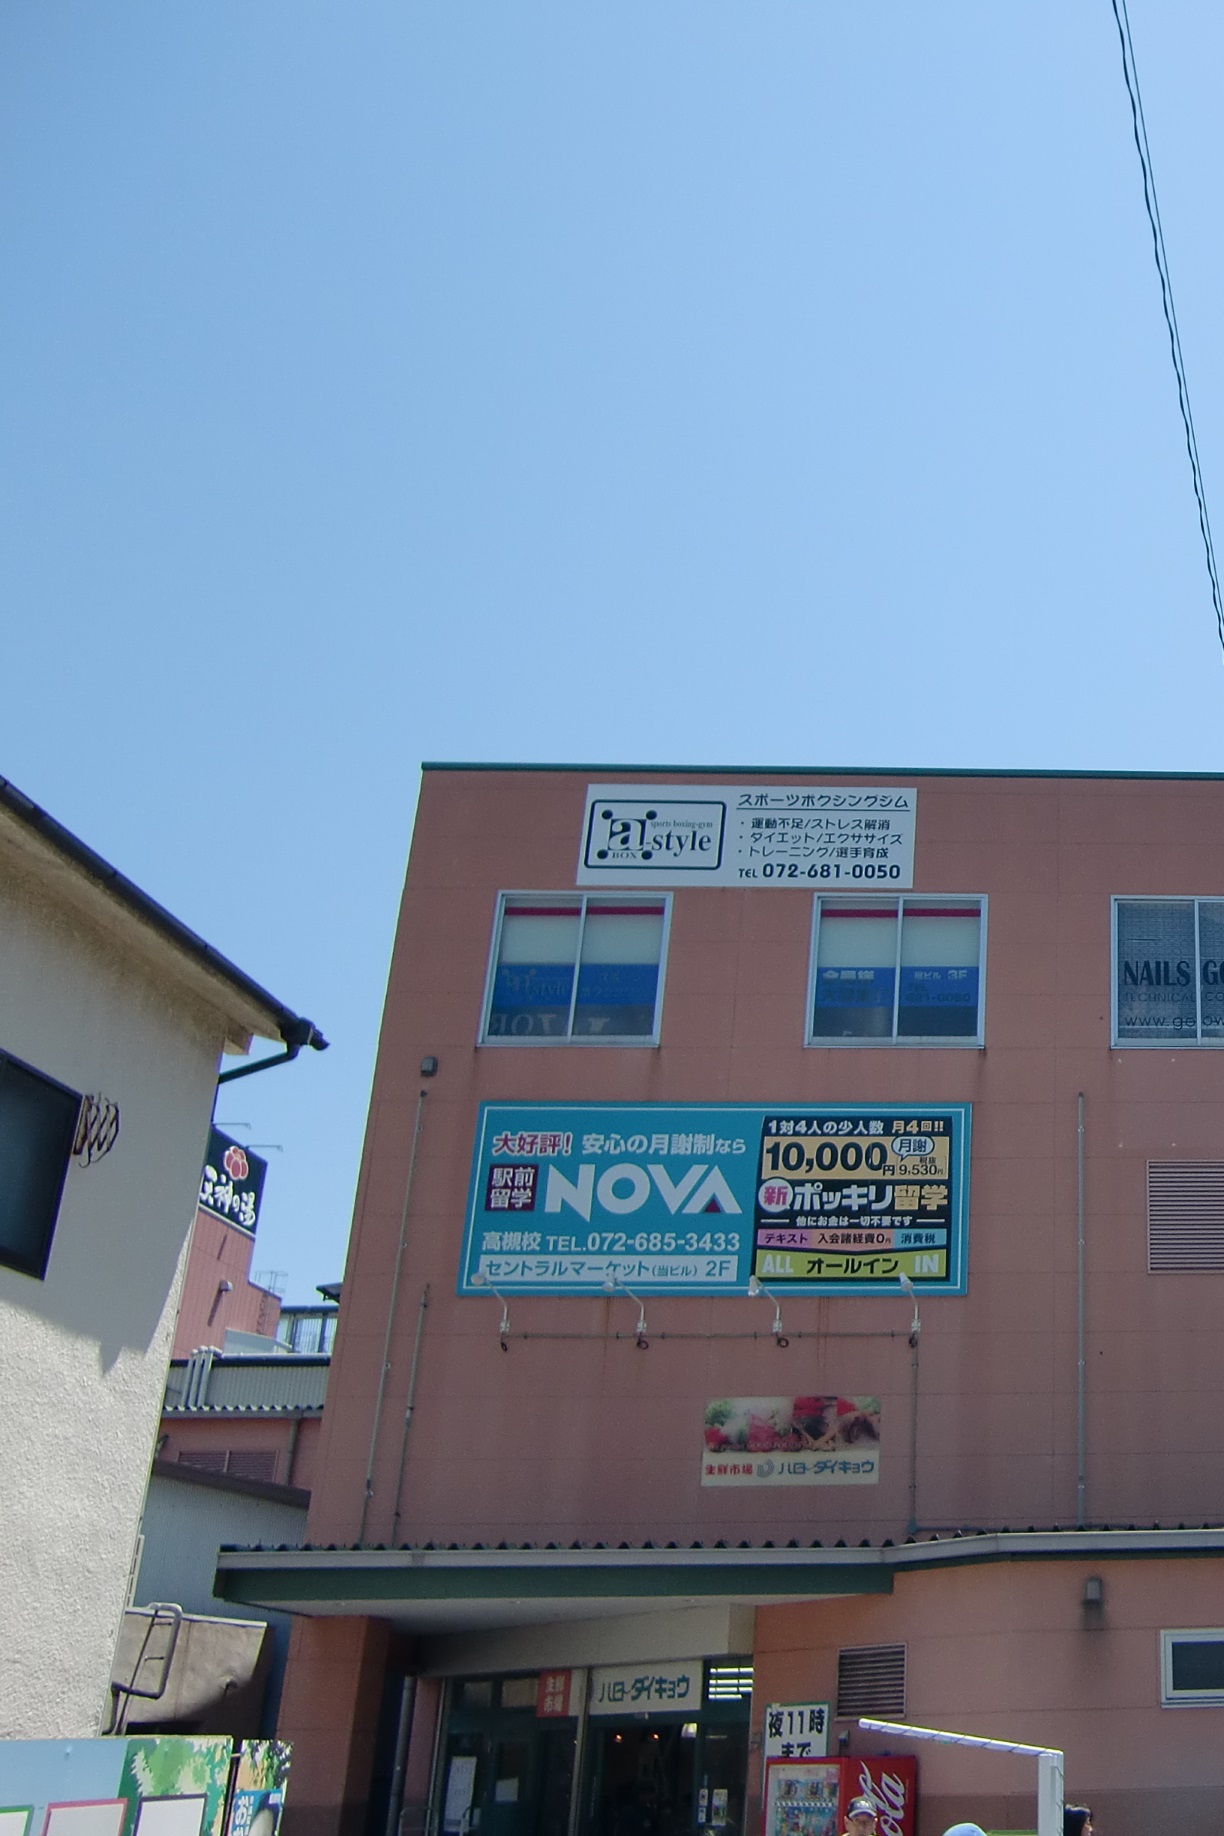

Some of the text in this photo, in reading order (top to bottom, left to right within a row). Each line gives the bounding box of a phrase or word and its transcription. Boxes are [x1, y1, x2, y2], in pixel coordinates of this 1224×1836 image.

[651, 819, 671, 829] sports
[751, 817, 891, 831] 運動不足/ストレス解消
[750, 832, 903, 845] ダイエット/エクササイズ
[749, 846, 889, 859] トレーニング/選手育成
[738, 863, 901, 879] TEL 072-681-0050
[1124, 960, 1191, 987] NAILS
[768, 1120, 884, 1135] 1対4人の少人数
[492, 1131, 746, 1156] 大好評! 安心の月謝制なら
[898, 1138, 927, 1152] 月謝
[491, 1167, 535, 1187] 駅前
[490, 1188, 532, 1209] 留学
[544, 1163, 743, 1223] NOVA
[763, 1185, 788, 1206] 新
[796, 1215, 913, 1227] 他にお金は一切不要です
[482, 1231, 542, 1251] 高槻校
[587, 1232, 740, 1251] 072-685-3433
[764, 1233, 808, 1244] テキスト
[901, 1233, 936, 1244] 消費税
[705, 1260, 732, 1277] 2F
[761, 1254, 794, 1274] ALL
[806, 1258, 899, 1275] オールイン
[914, 1254, 939, 1273] IN
[705, 1463, 753, 1476] 生鮮市場
[768, 1709, 825, 1738] 夜11時
